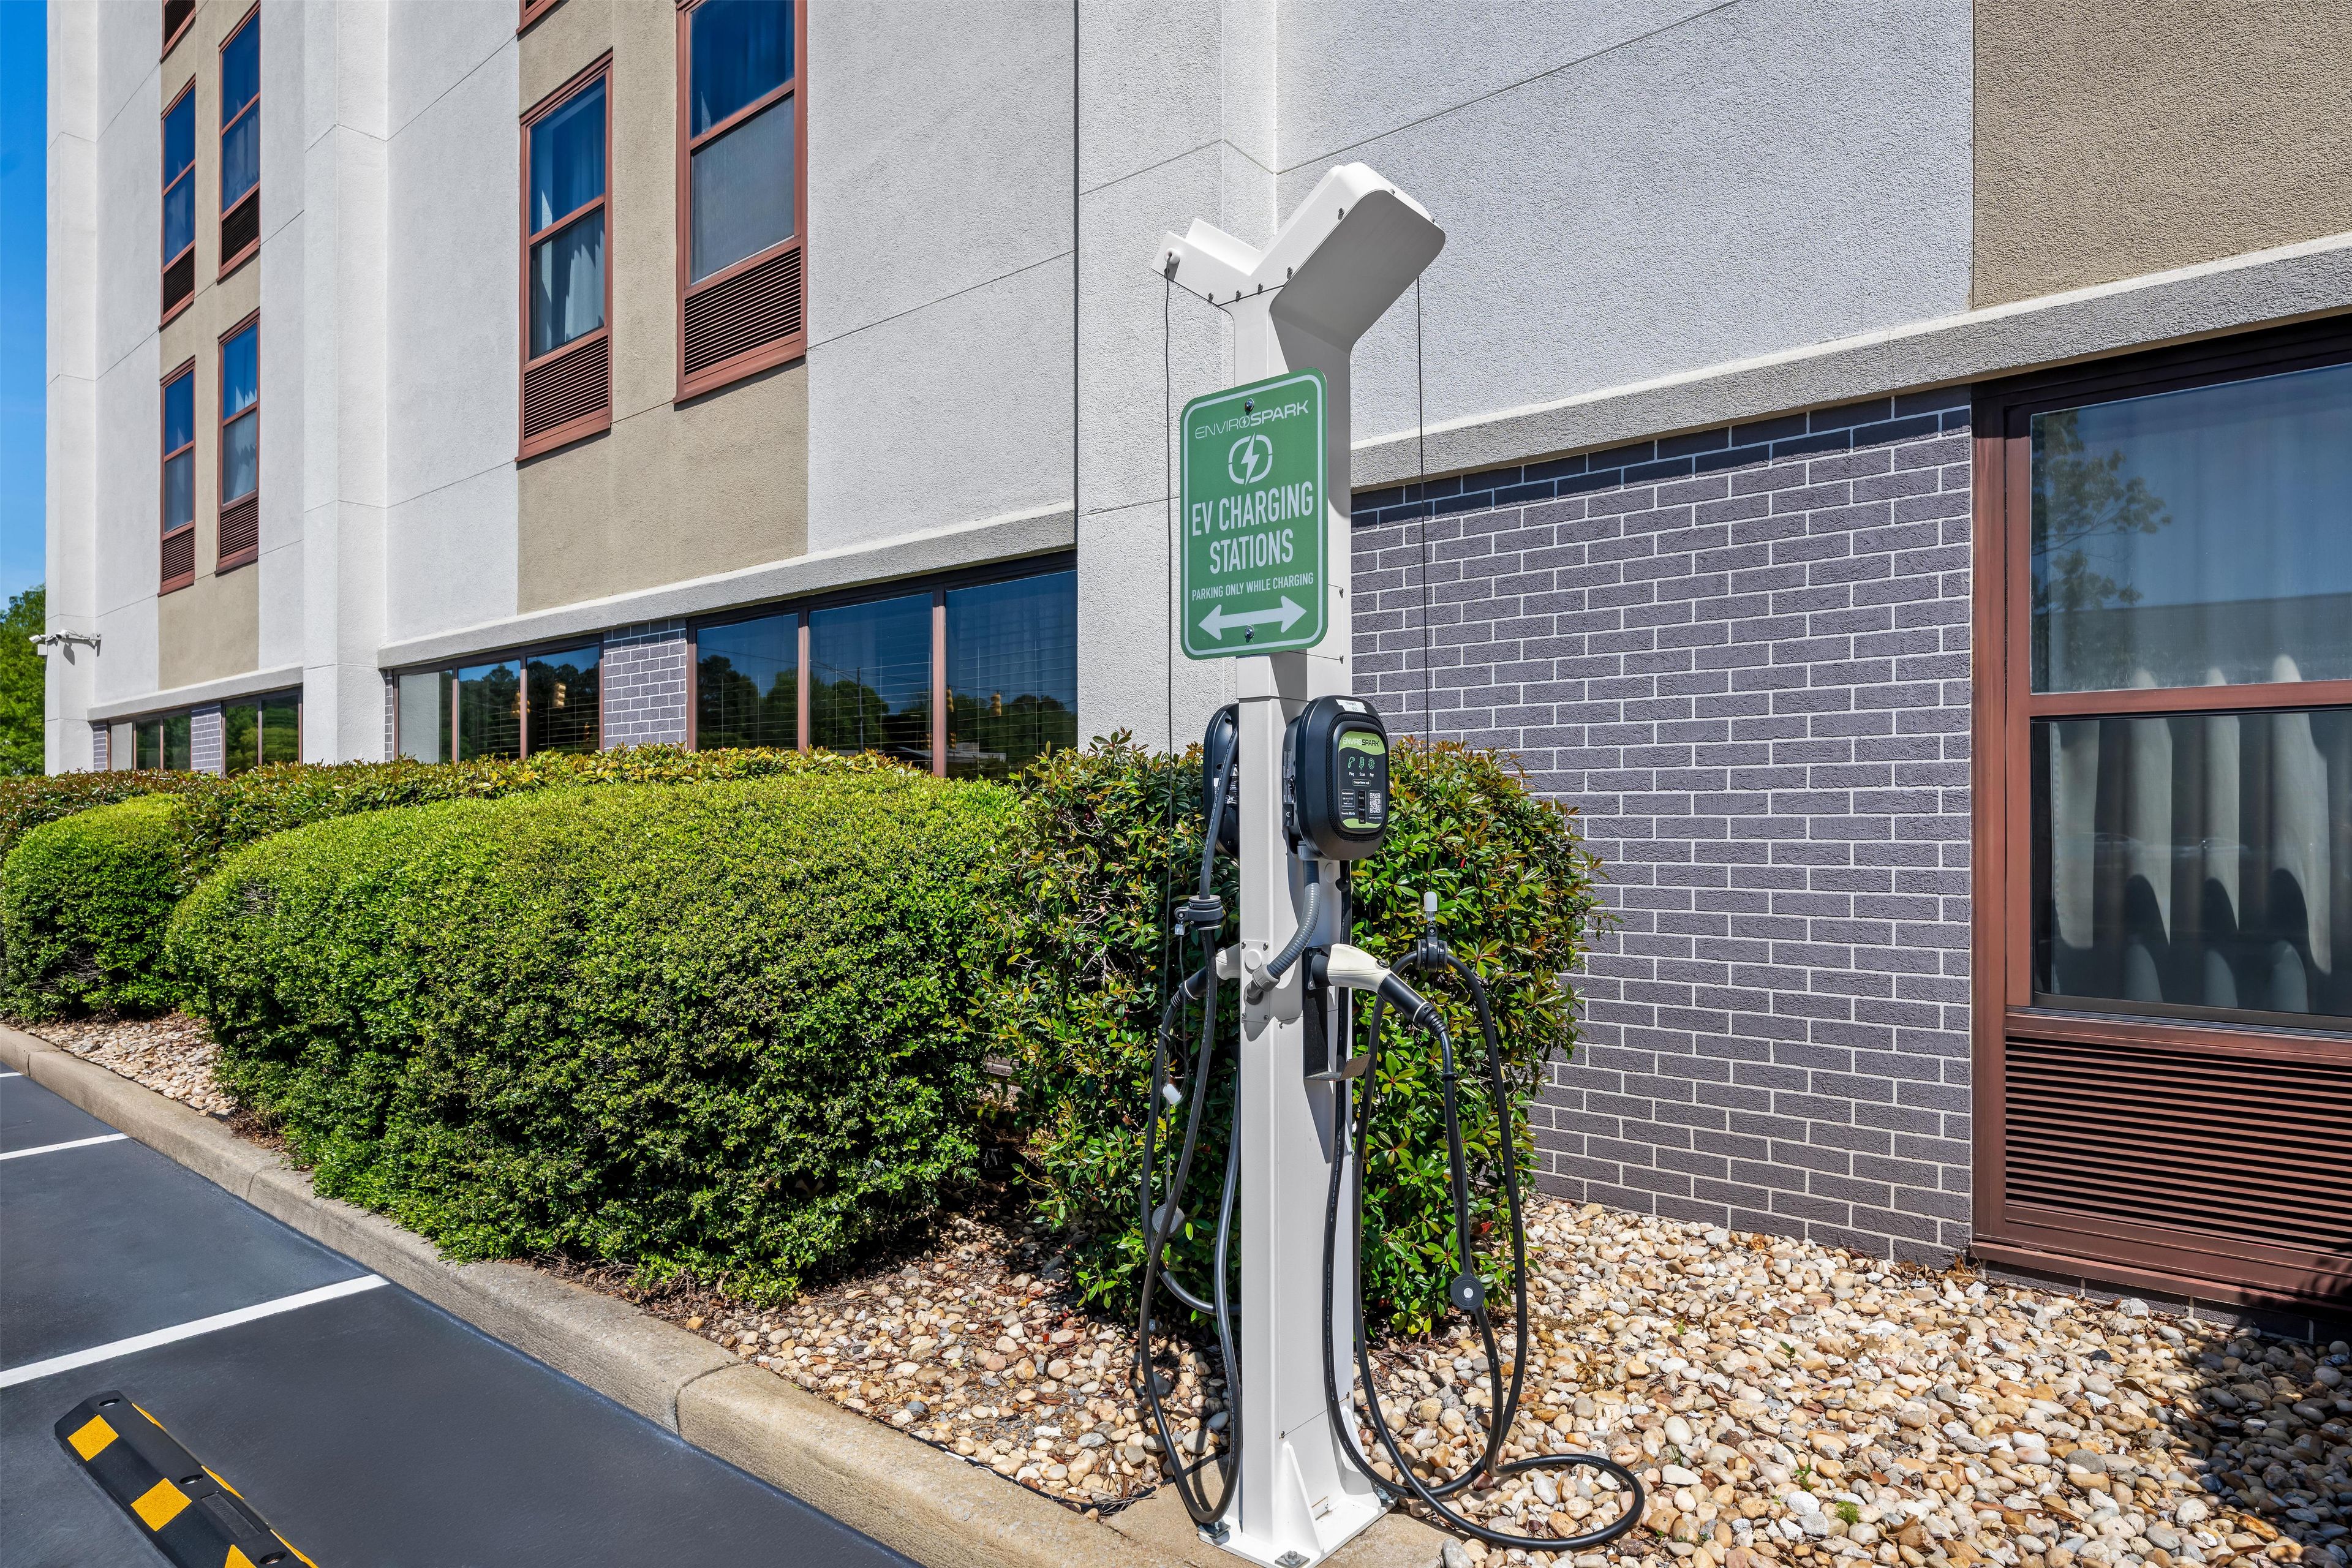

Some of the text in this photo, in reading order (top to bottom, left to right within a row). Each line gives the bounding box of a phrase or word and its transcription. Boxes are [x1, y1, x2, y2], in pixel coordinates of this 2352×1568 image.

[1192, 481, 1314, 537] EV CHARGING
[1210, 528, 1294, 575] STATIONS
[1192, 572, 1314, 601] PARKING ONLY WHILE CHARGING
